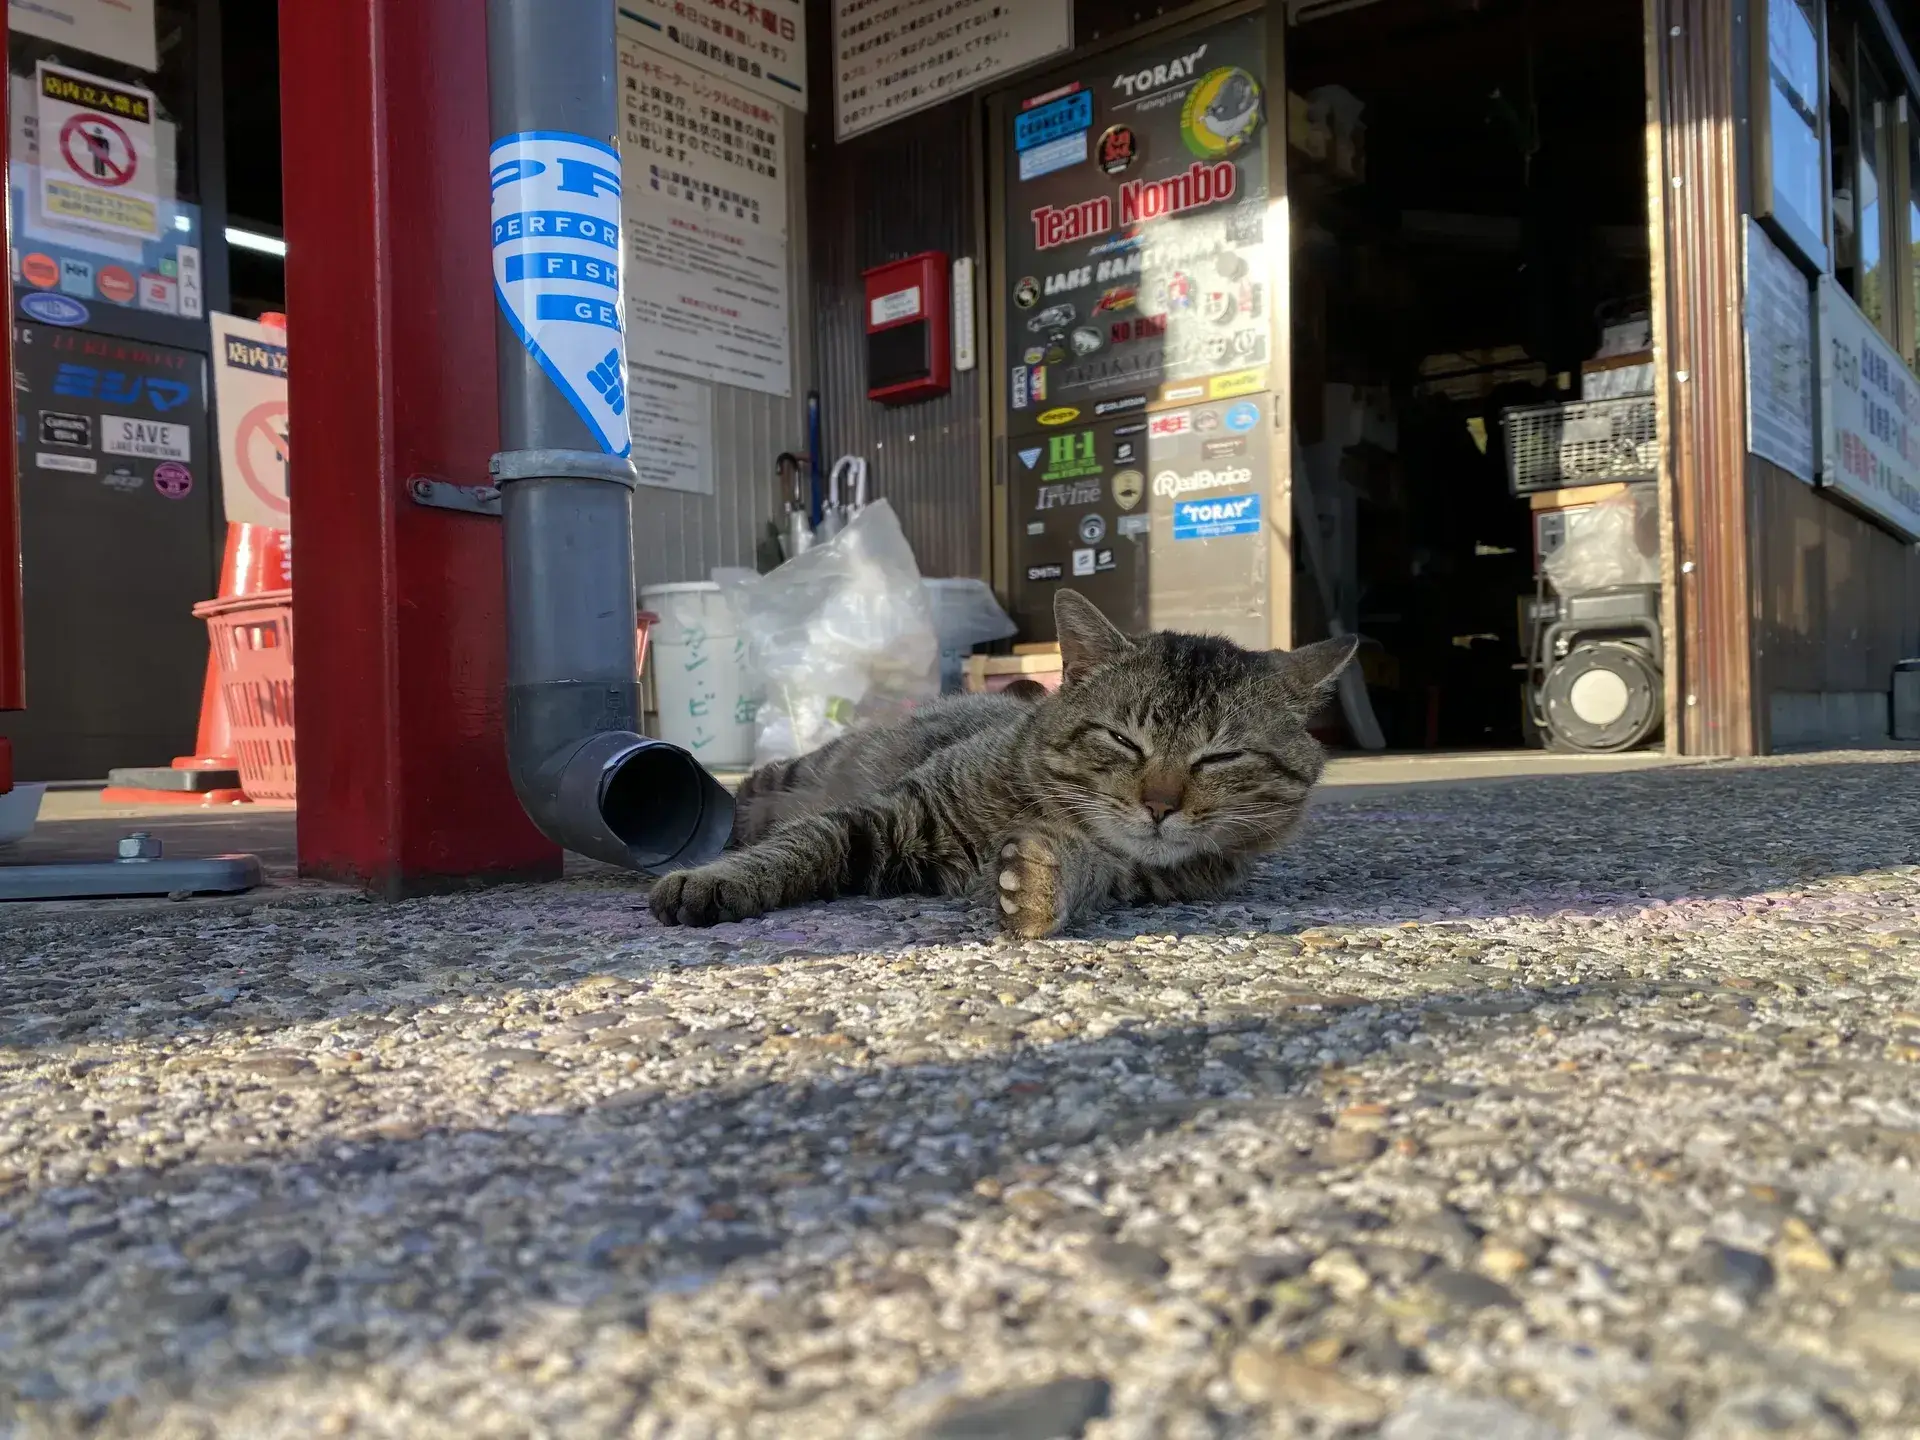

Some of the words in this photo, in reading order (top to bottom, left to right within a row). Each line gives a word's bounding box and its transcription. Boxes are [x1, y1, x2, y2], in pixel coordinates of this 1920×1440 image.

[1032, 195, 1112, 250] Team
[1120, 161, 1236, 226] Nombo
[547, 257, 618, 286] FISH
[575, 302, 621, 330] GE
[123, 421, 169, 444] SAVE
[1028, 565, 1062, 580] SMITH
